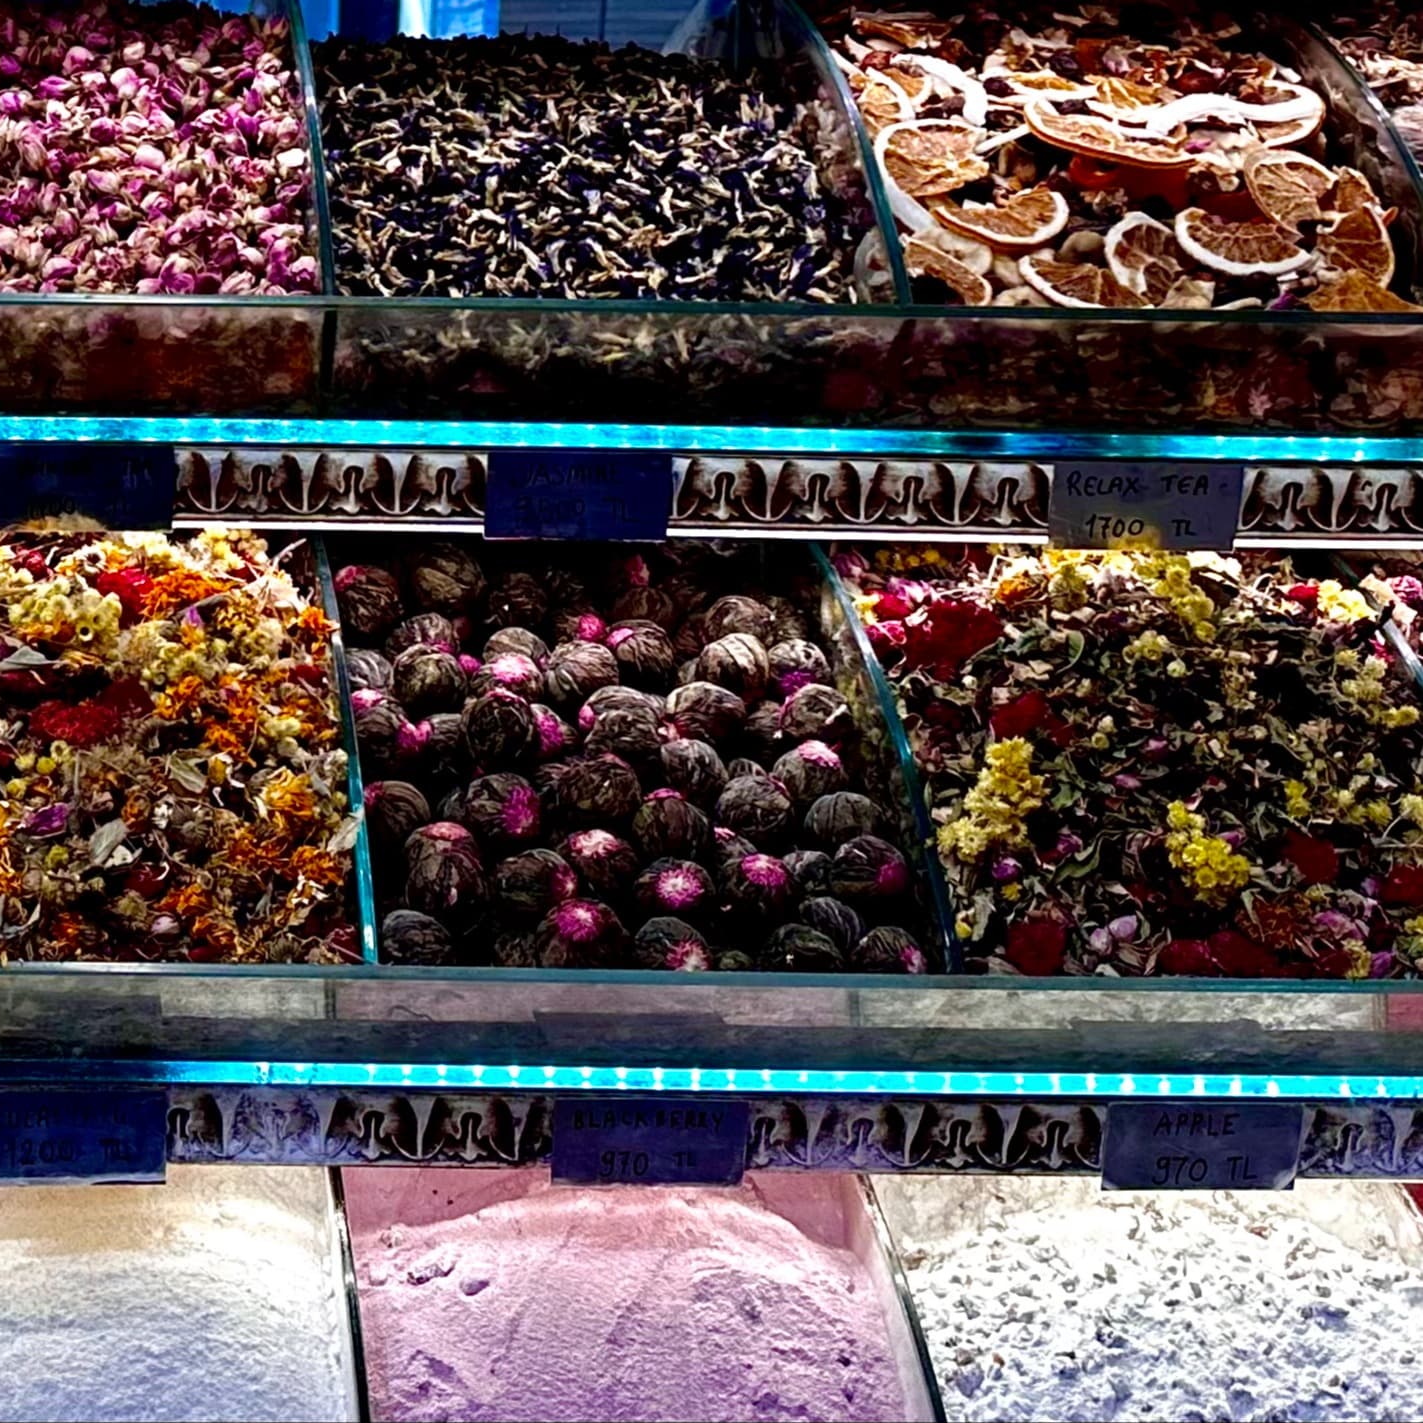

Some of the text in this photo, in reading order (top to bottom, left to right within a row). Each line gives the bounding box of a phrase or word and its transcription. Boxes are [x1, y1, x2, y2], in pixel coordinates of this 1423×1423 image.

[1066, 470, 1209, 497] RELAX TEA
[1085, 513, 1197, 539] 1700 TL
[1153, 1111, 1241, 1137] APPLE
[599, 1150, 698, 1178] 970 TL
[1151, 1156, 1258, 1186] 970 TL
